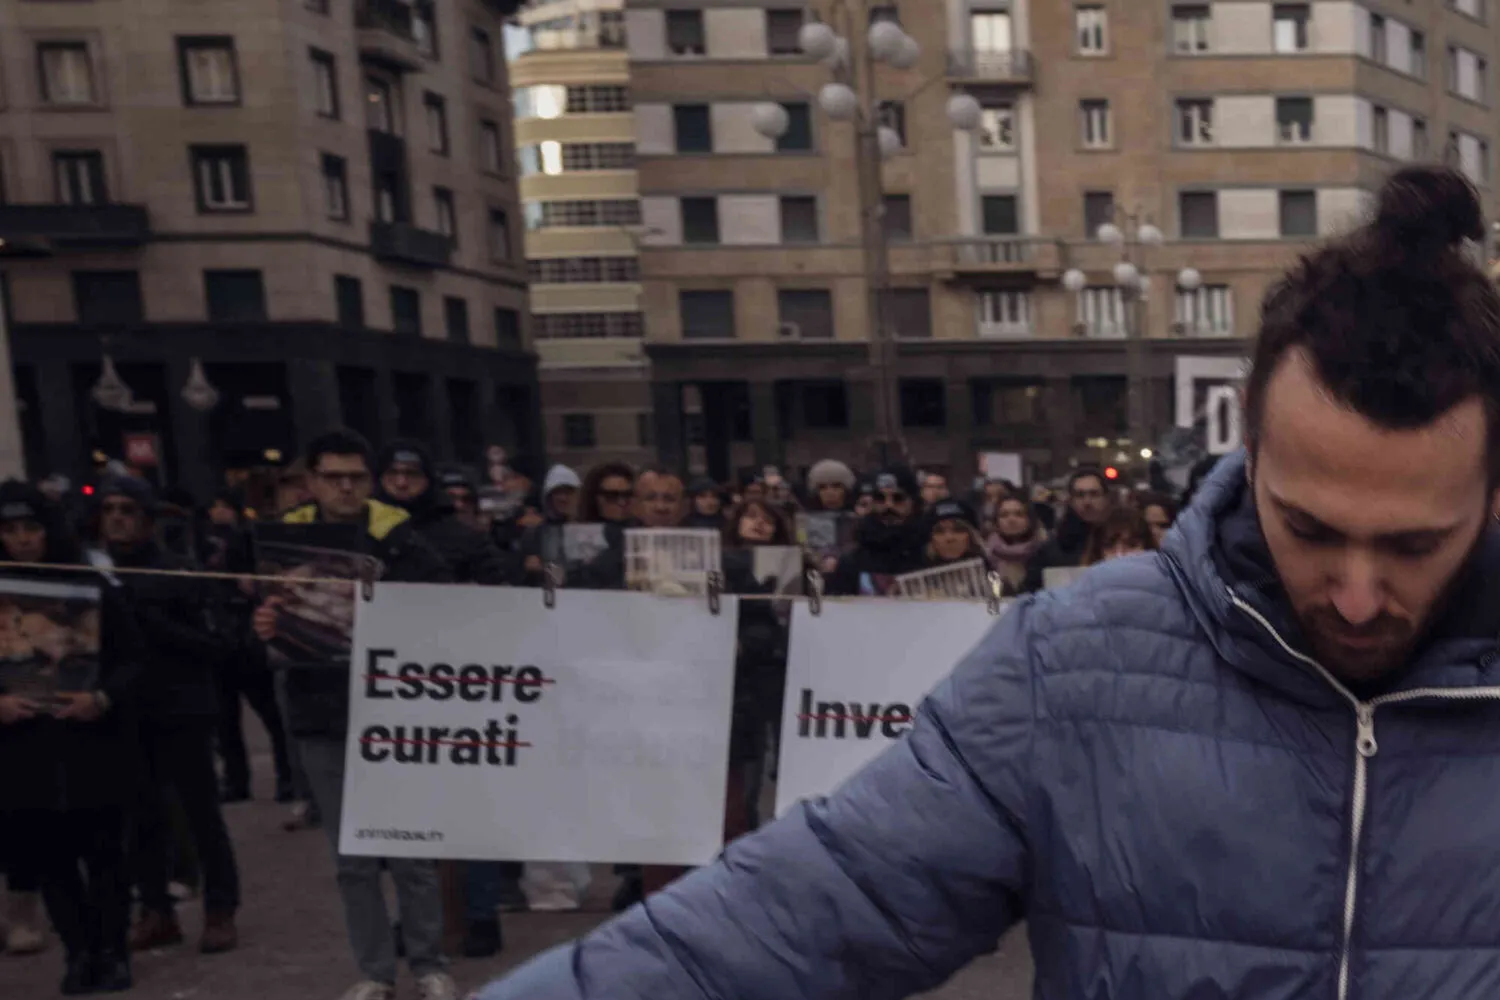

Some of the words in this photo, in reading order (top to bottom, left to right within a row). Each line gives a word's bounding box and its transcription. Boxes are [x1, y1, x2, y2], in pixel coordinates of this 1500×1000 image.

[365, 648, 543, 703] Essere
[360, 714, 518, 766] curati
[798, 689, 911, 740] Inve
